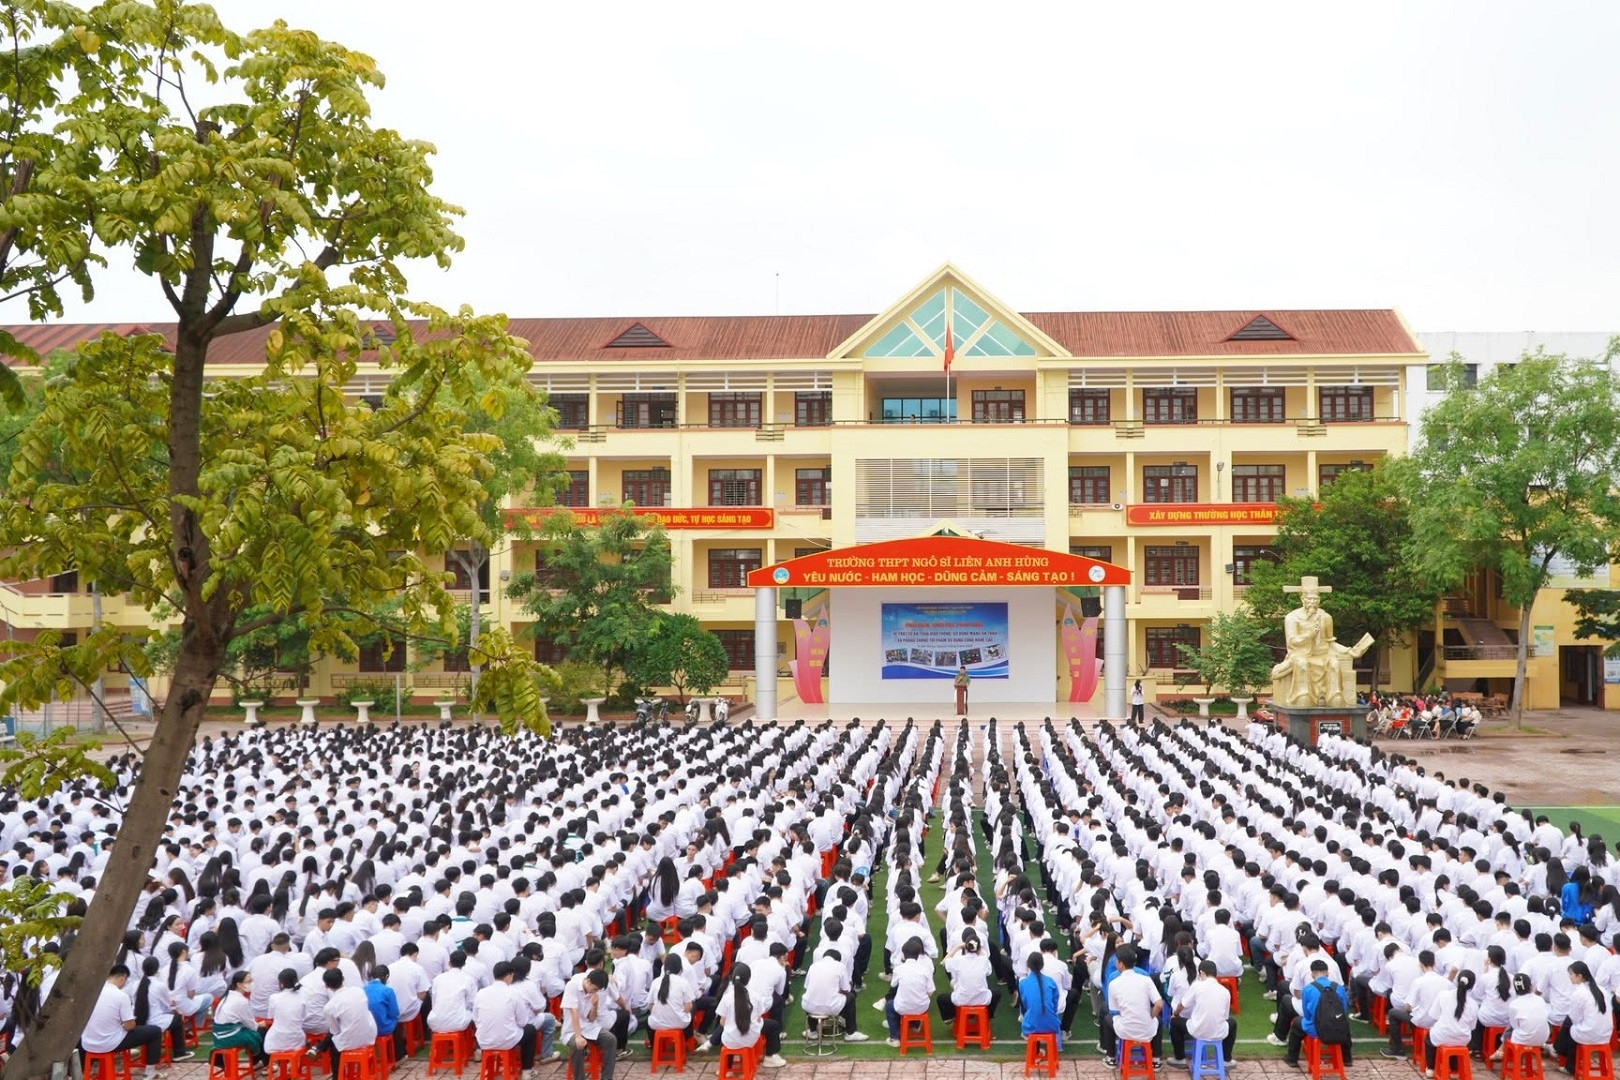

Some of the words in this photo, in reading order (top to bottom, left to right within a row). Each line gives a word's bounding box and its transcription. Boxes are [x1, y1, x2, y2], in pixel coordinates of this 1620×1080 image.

[702, 514, 716, 525] HỌC
[717, 512, 736, 524] SÁNG
[737, 514, 752, 525] TẠO
[1149, 510, 1166, 520] XÂY
[1168, 510, 1192, 521] DỰNG
[1194, 508, 1228, 520] TRƯỜNG
[1230, 510, 1248, 520] HỌC
[1249, 508, 1272, 518] THÂN
[827, 556, 875, 568] TRƯỜNG
[878, 558, 909, 568] THPT
[912, 556, 938, 567] NGÔ
[954, 555, 982, 567] LIÊN
[986, 558, 1012, 567] ANH
[1015, 556, 1049, 567] HÙNG
[803, 570, 826, 582] YÊU
[829, 570, 862, 582] NƯỚC
[872, 572, 898, 582] HAM
[900, 572, 925, 584] HỌC
[934, 570, 967, 582] DŨNG
[970, 570, 997, 582] CẢM
[1007, 570, 1039, 582] SÁNG
[1043, 572, 1068, 584] TẠO
